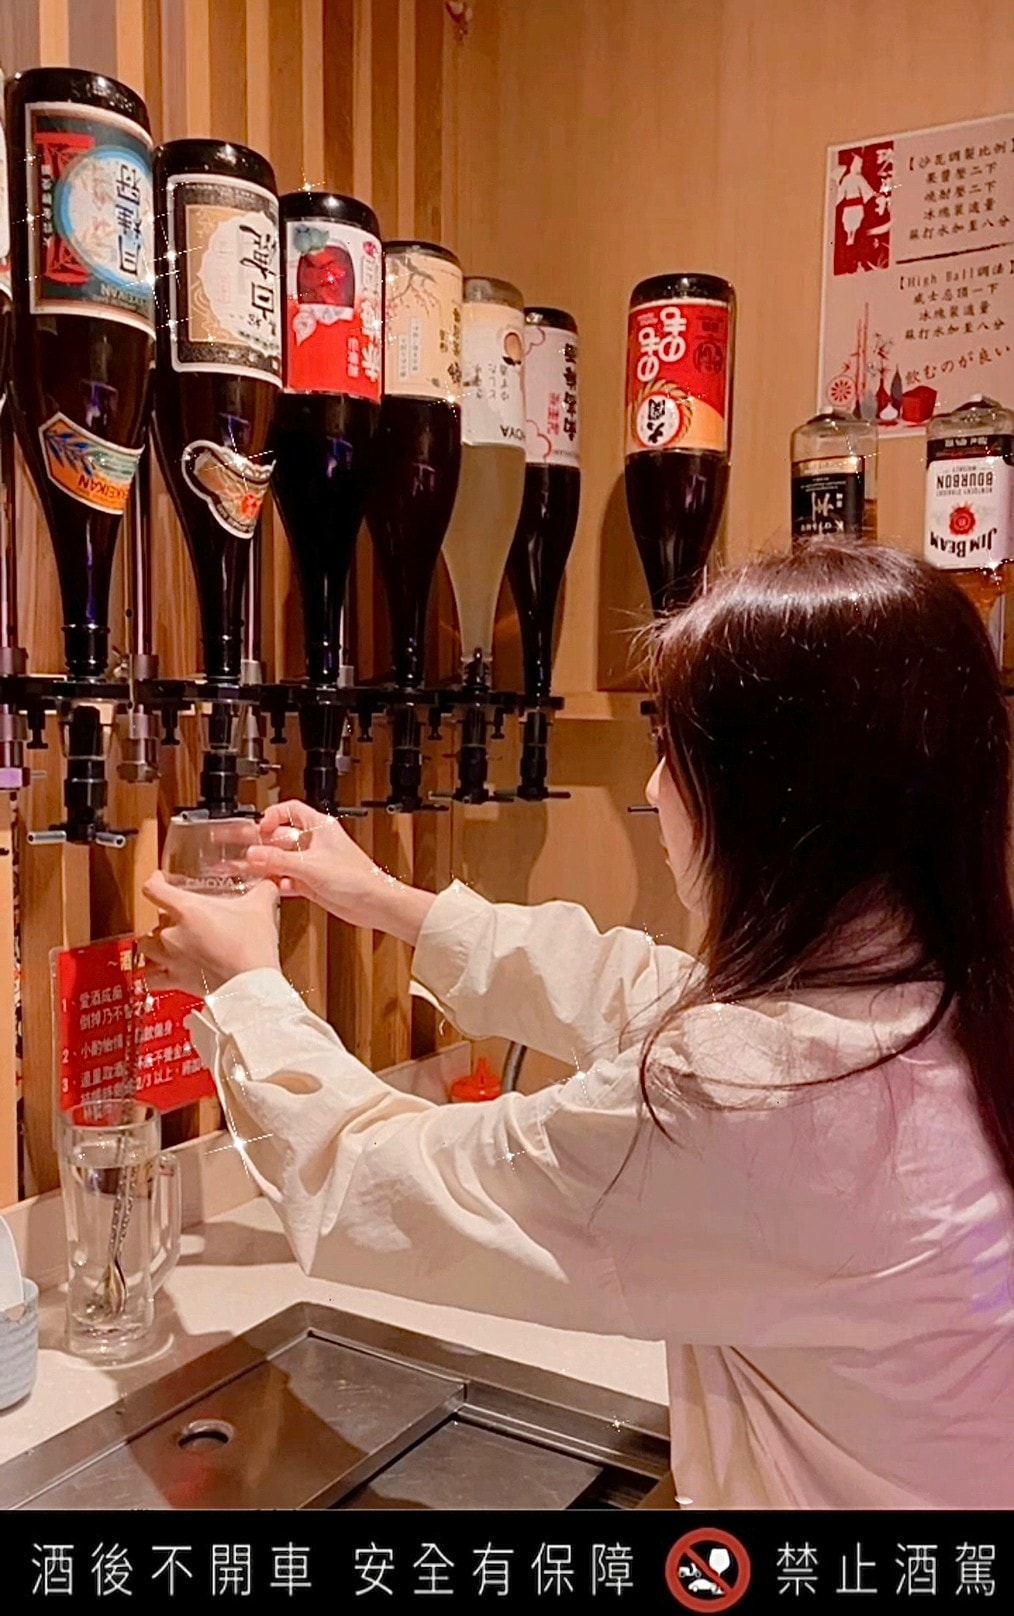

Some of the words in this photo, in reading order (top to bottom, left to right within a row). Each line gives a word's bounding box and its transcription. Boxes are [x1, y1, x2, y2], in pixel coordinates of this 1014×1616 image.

[936, 471, 994, 490] BOURBON
[930, 530, 967, 558] BEAM
[969, 528, 998, 551] JIM
